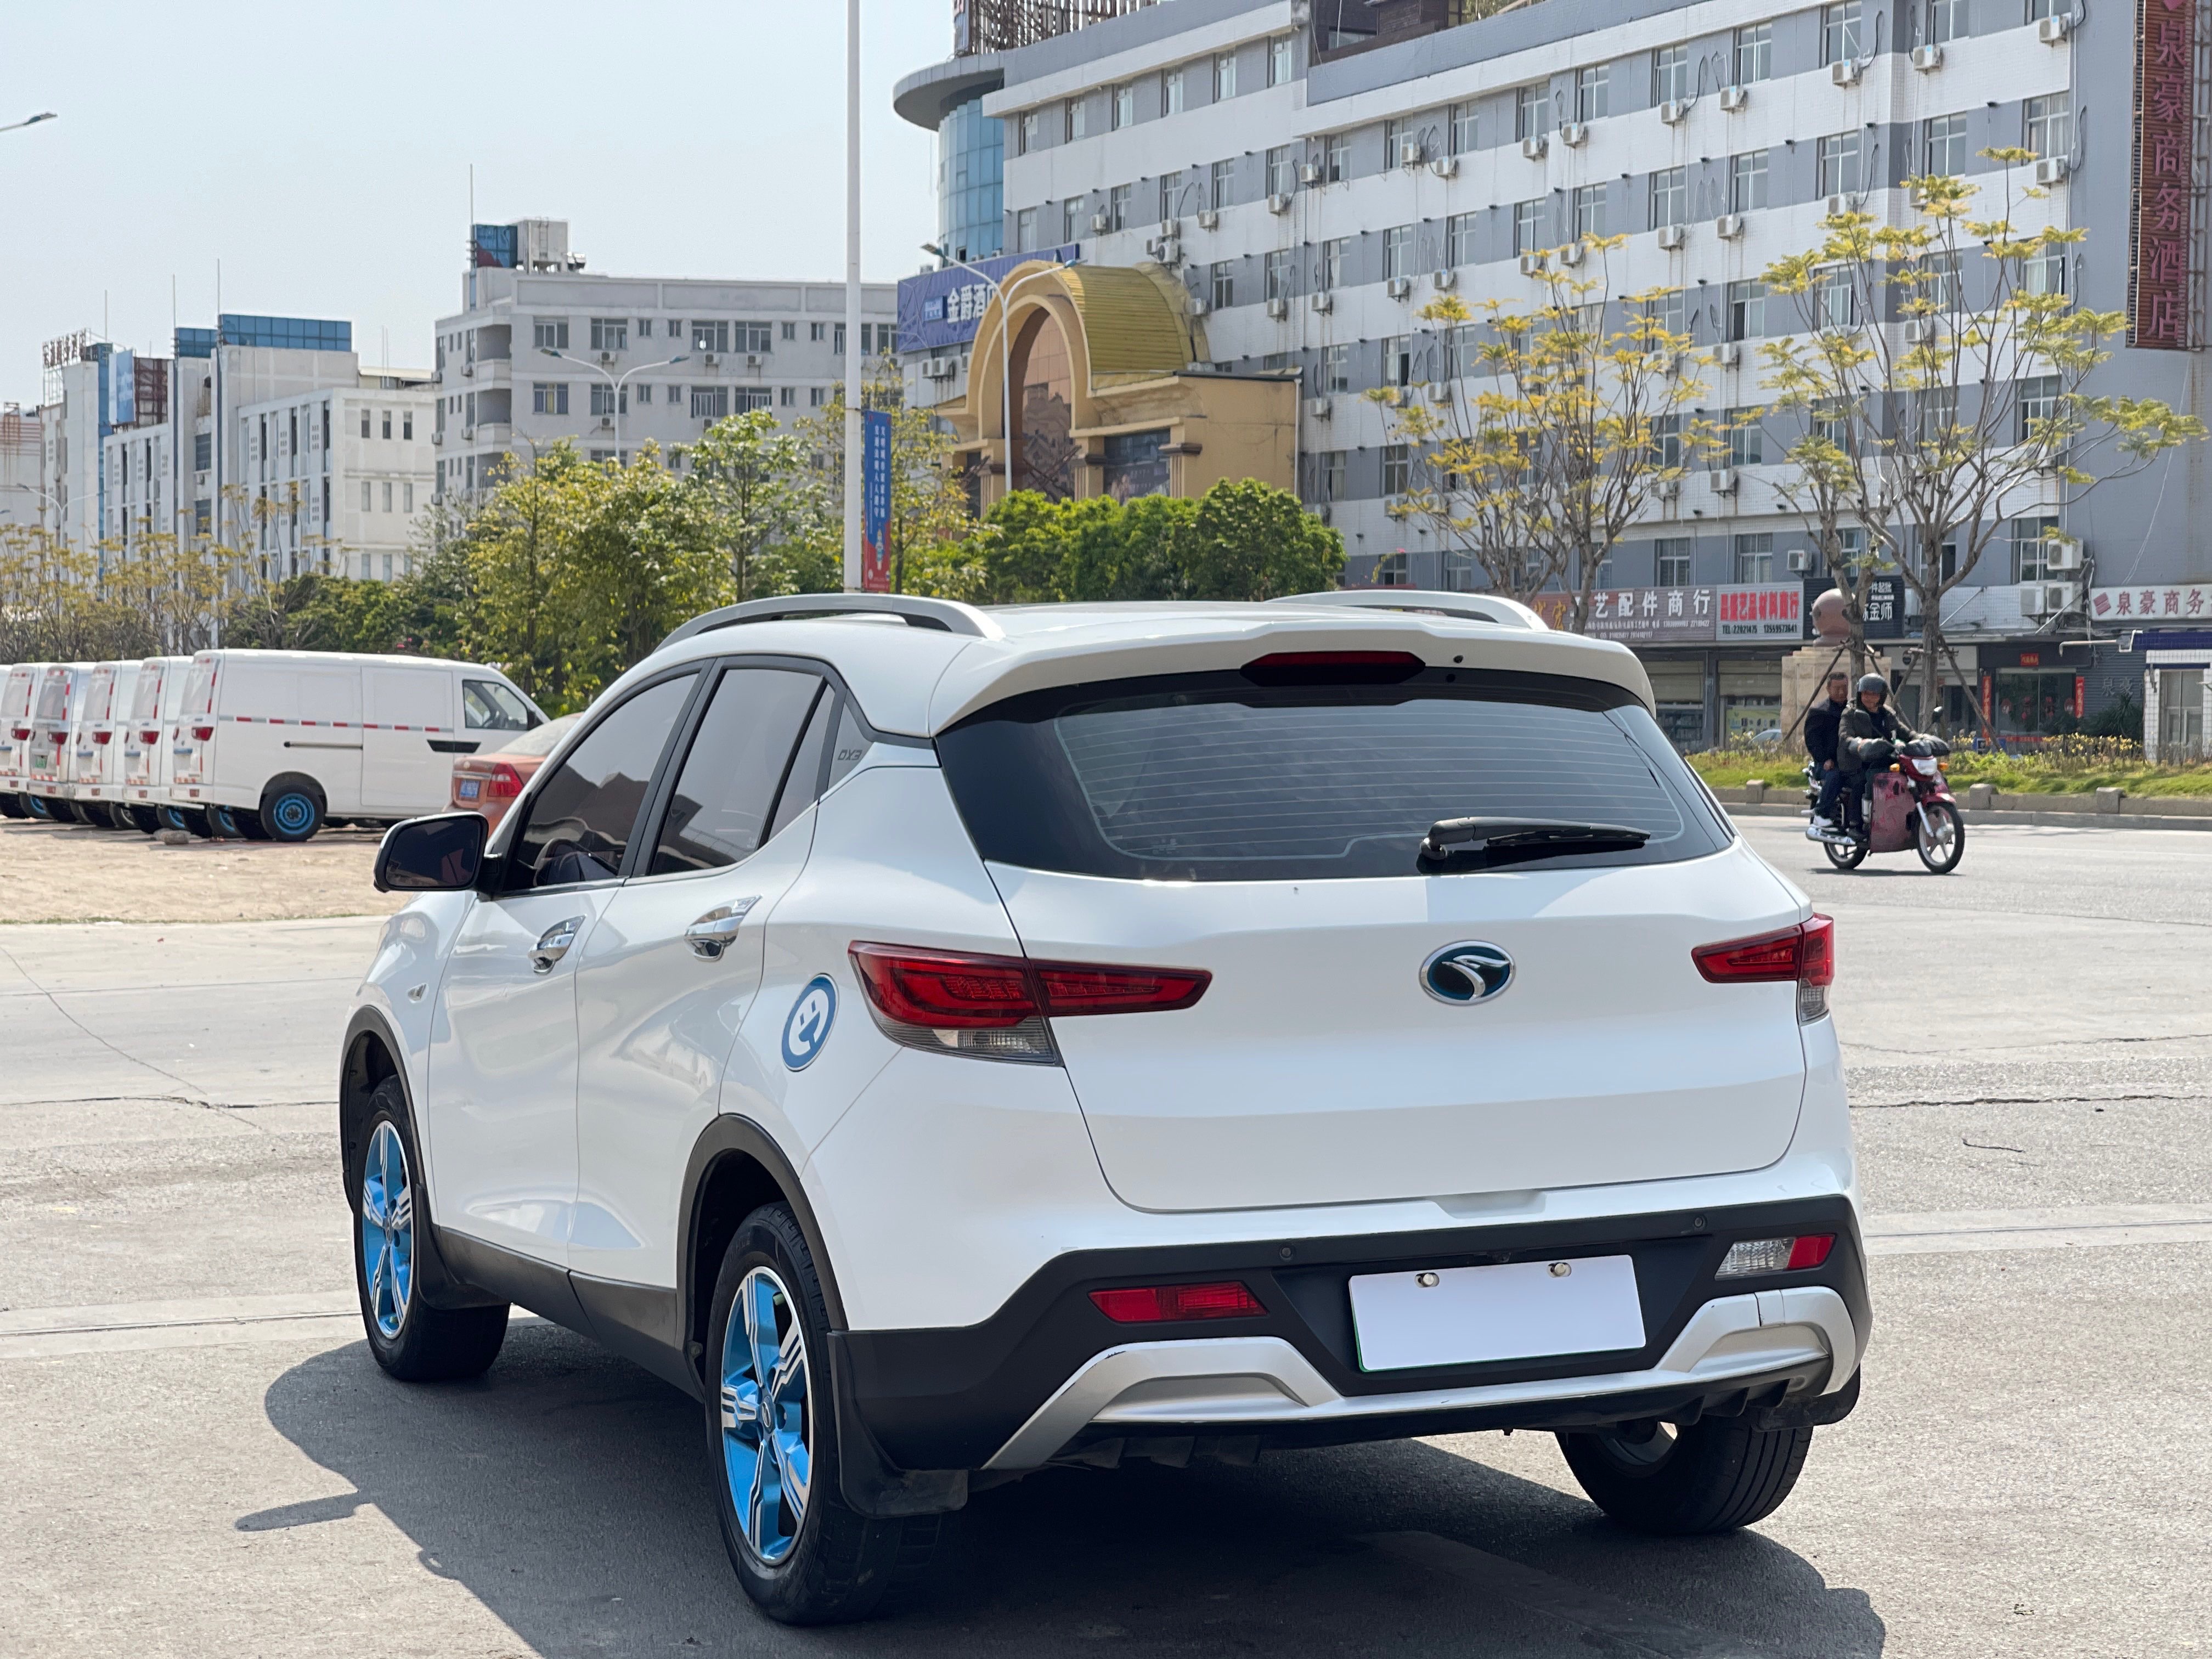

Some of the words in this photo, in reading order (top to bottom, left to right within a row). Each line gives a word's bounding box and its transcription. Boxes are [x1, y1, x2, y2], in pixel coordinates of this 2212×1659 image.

[2147, 20, 2187, 339] 泉豪商务酒店
[1870, 581, 1892, 594] 件起批
[2116, 588, 2212, 615] 泉豪商务
